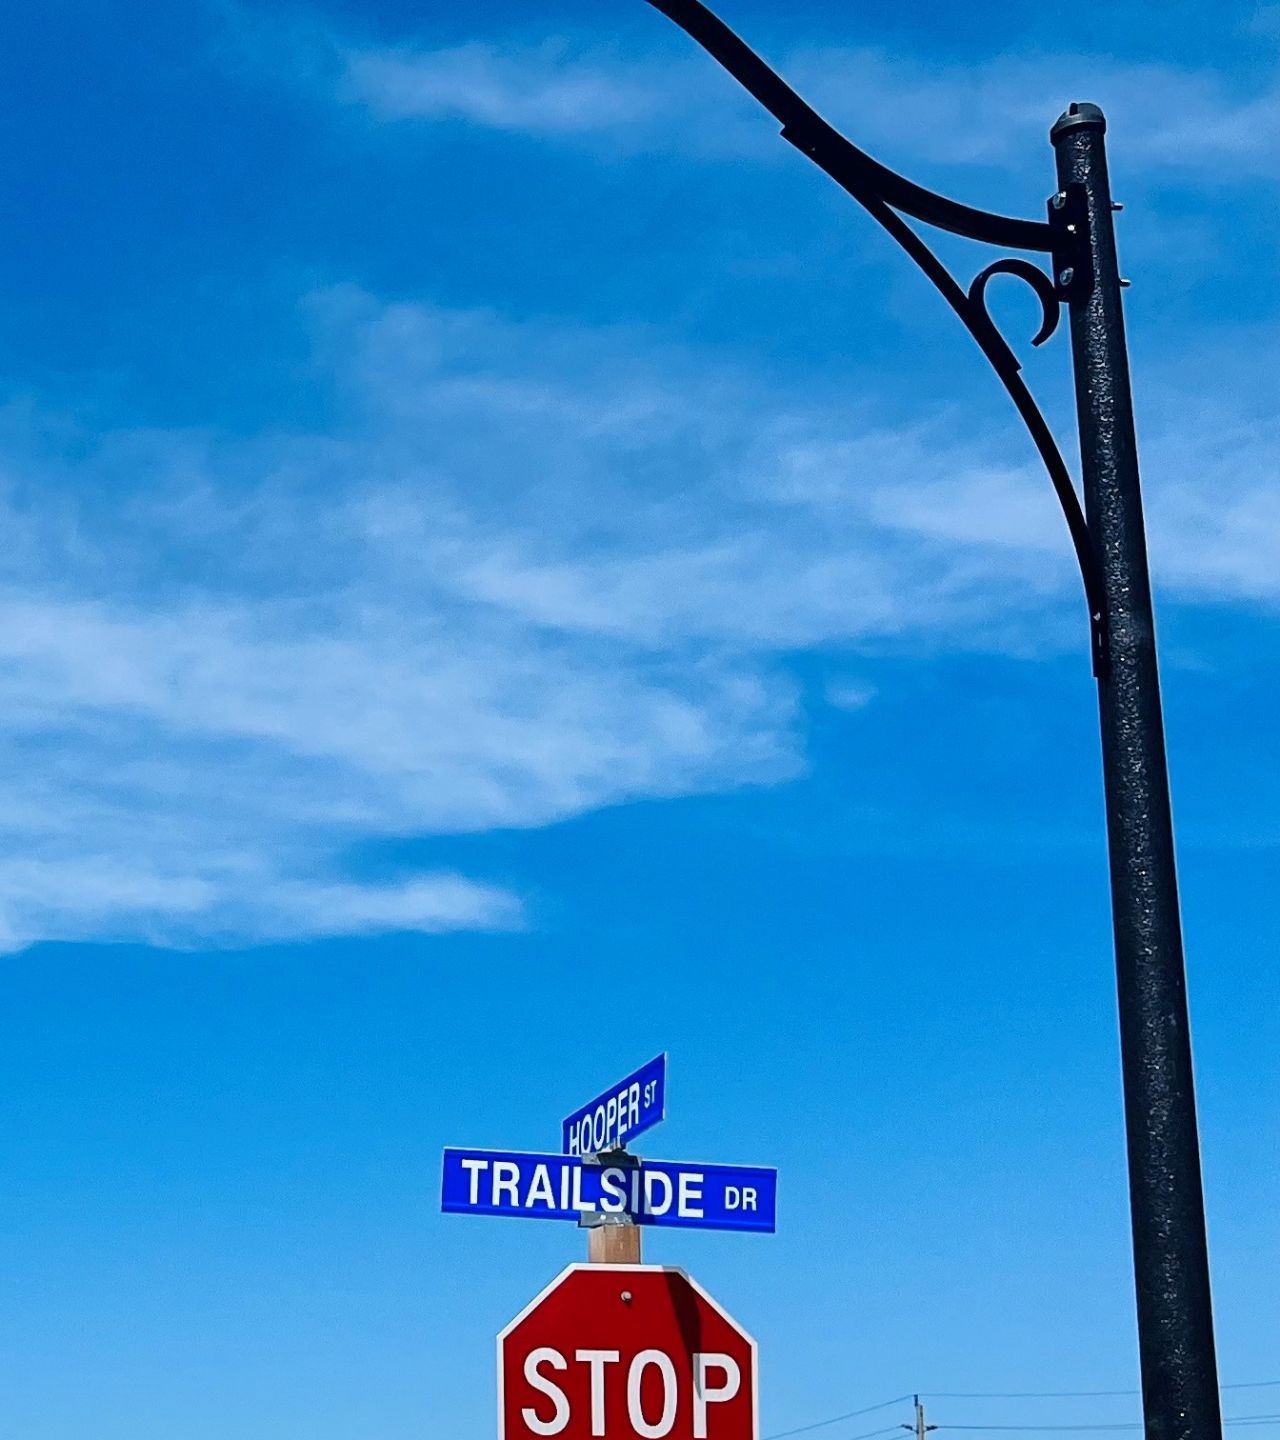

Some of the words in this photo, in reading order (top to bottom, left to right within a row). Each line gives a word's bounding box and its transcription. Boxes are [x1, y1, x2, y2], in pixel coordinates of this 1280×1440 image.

[569, 1082, 640, 1155] HOOPER
[643, 1079, 657, 1109] ST
[461, 1158, 704, 1219] TRAILSIDE
[724, 1185, 758, 1212] DR
[521, 1346, 741, 1439] STOP
